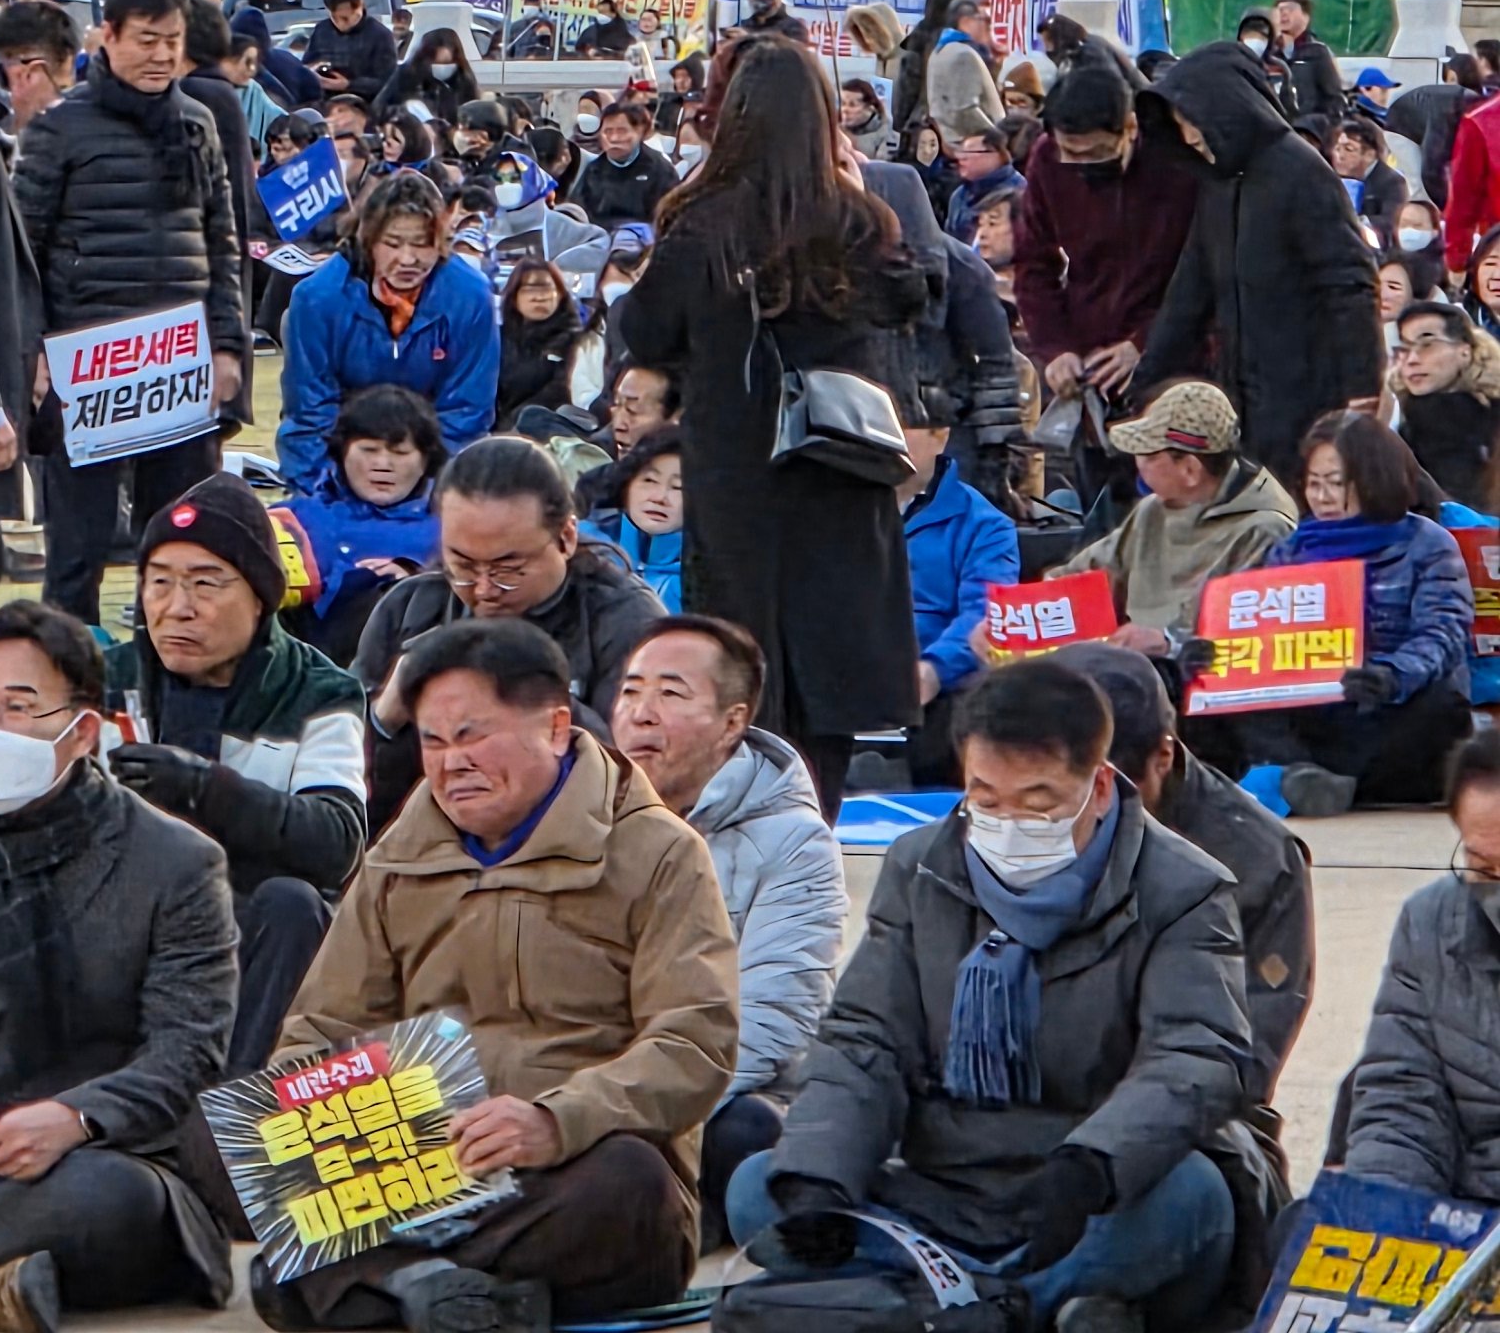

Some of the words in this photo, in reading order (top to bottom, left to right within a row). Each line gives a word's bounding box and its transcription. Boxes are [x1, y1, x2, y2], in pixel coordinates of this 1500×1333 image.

[275, 169, 343, 232] 구리시
[71, 320, 199, 385] 내란세력
[72, 364, 210, 431] 제압하자!
[1228, 583, 1326, 629] 윤석열
[1272, 628, 1356, 671] 파면!
[286, 1051, 374, 1100] 내란수괴
